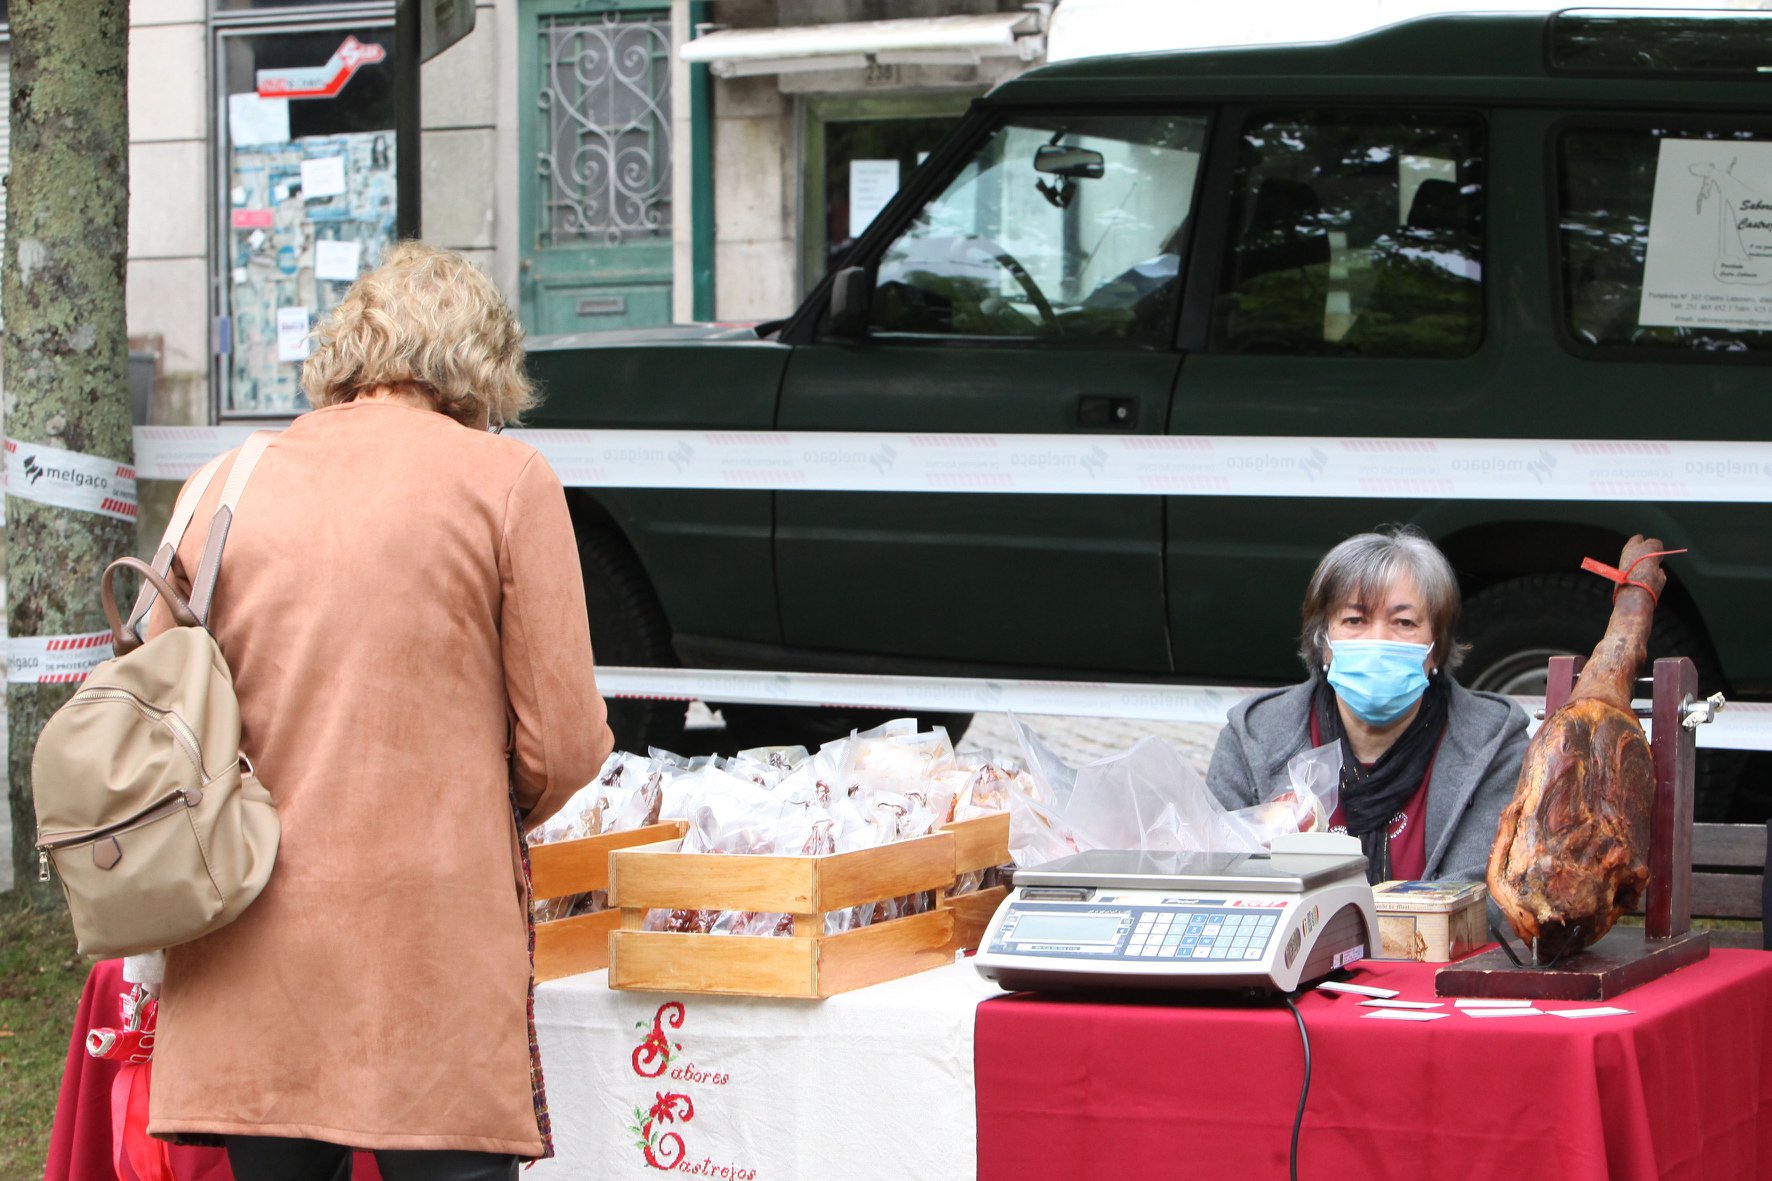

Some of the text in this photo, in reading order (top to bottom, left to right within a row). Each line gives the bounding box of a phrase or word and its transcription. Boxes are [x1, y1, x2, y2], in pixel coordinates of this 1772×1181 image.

[46, 467, 108, 489] melgaço
[632, 1001, 730, 1085] Sabores
[643, 1091, 757, 1181] Castrejos
